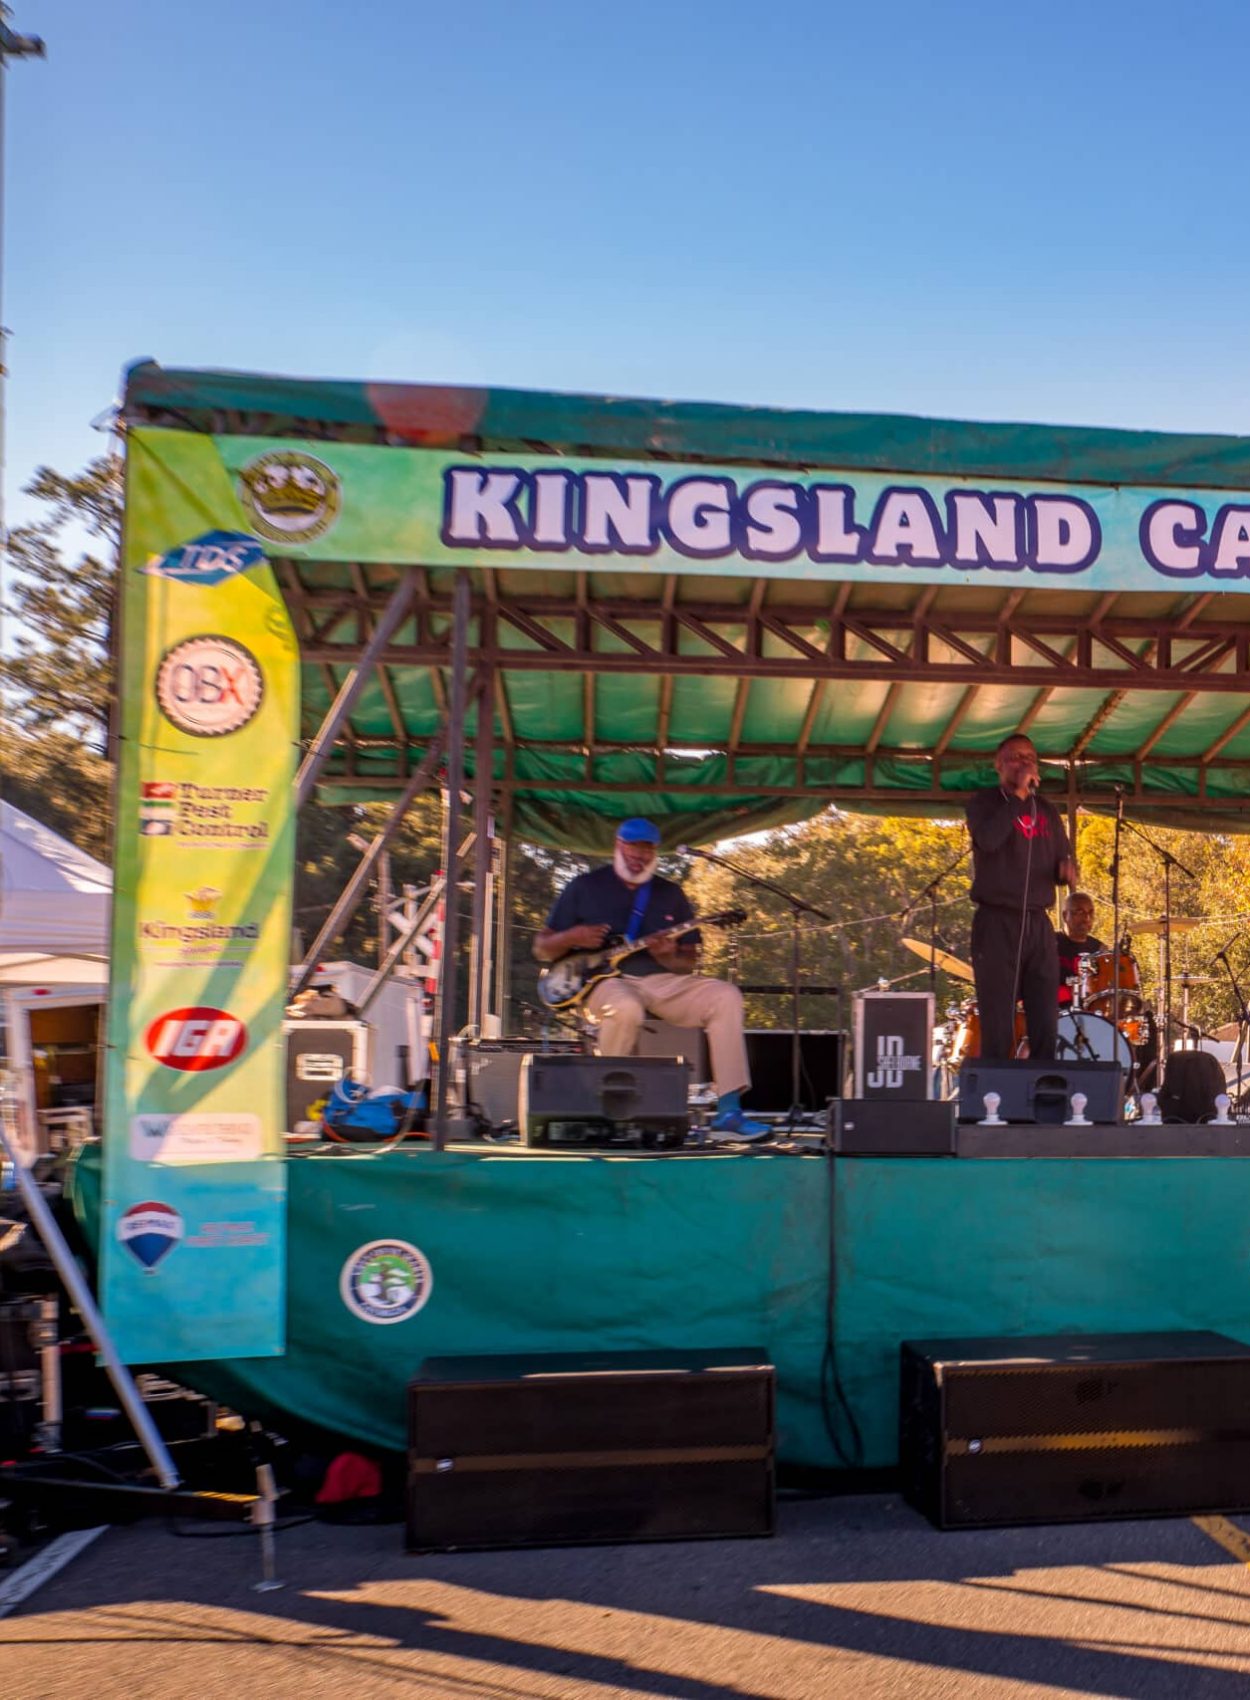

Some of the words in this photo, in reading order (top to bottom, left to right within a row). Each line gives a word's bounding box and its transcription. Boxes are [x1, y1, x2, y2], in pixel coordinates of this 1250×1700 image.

[442, 465, 1101, 573] KINGSLAND
[177, 782, 269, 801] Turner
[178, 801, 232, 819] Pest
[177, 820, 269, 838] Control
[154, 1018, 240, 1058] IGA
